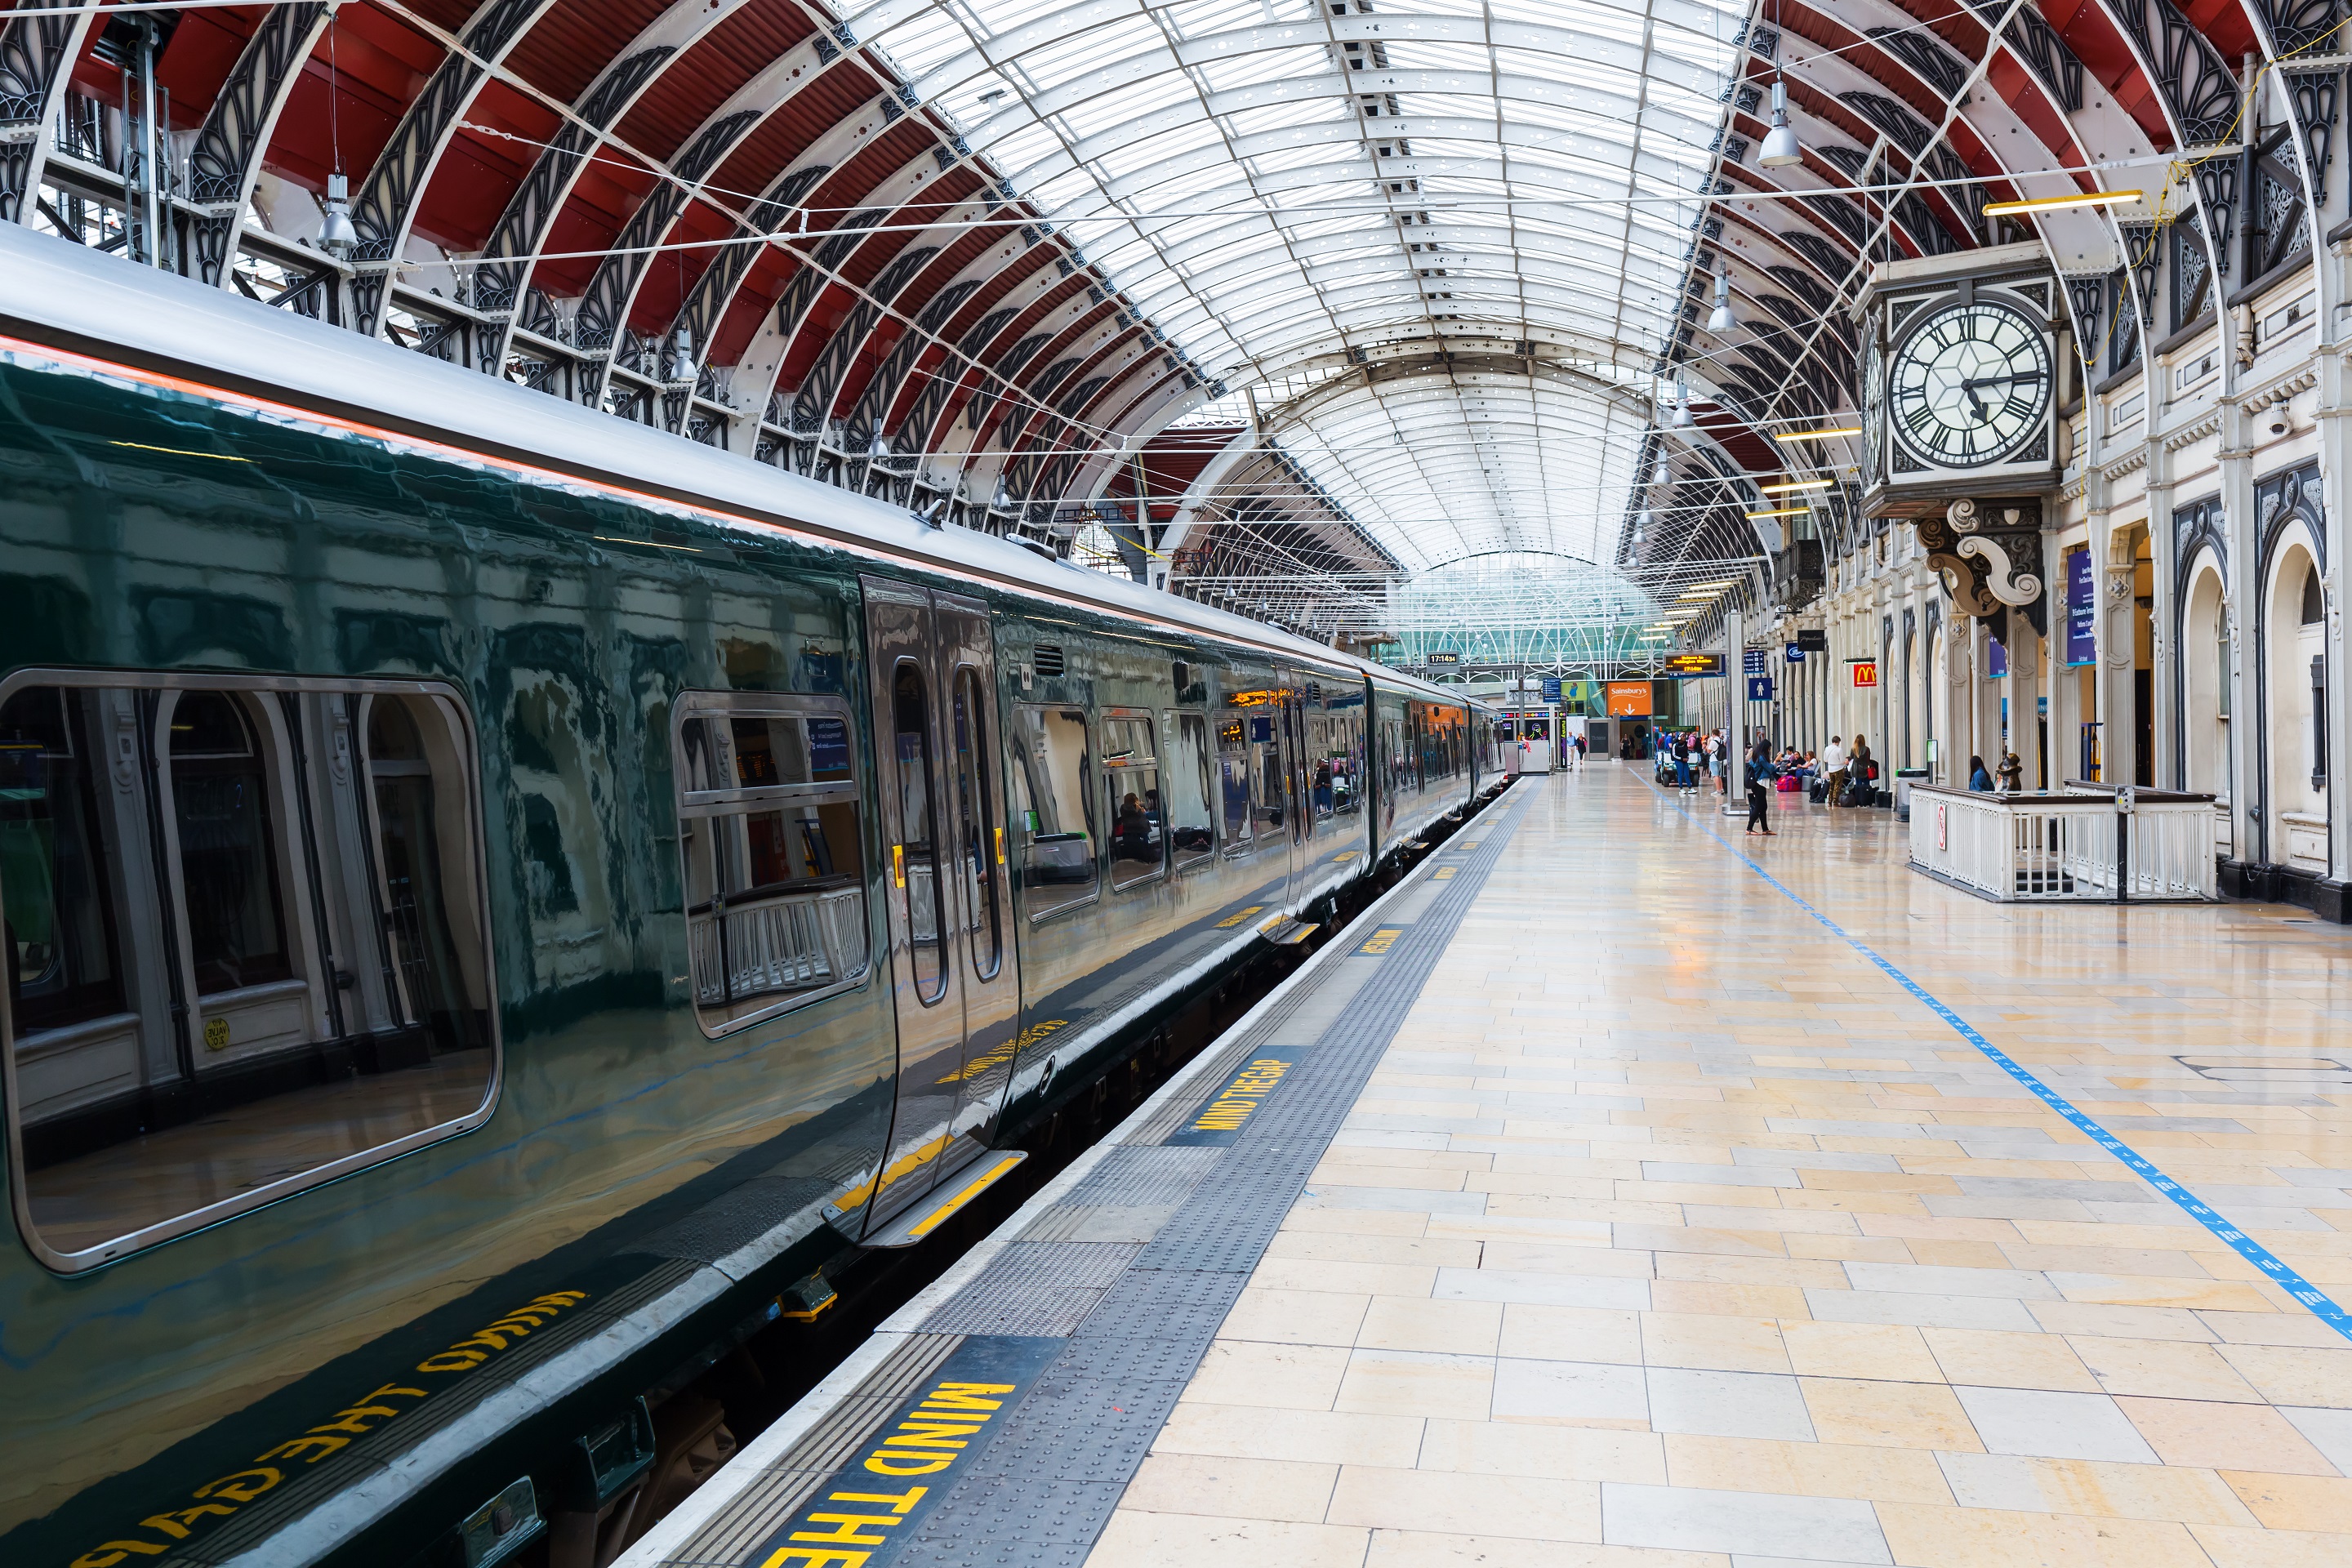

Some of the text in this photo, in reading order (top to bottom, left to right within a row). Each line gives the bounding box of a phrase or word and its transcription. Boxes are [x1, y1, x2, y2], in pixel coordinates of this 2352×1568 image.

[1193, 1059, 1293, 1130] MIND THE GAP
[759, 1382, 1016, 1568] MIND THE
